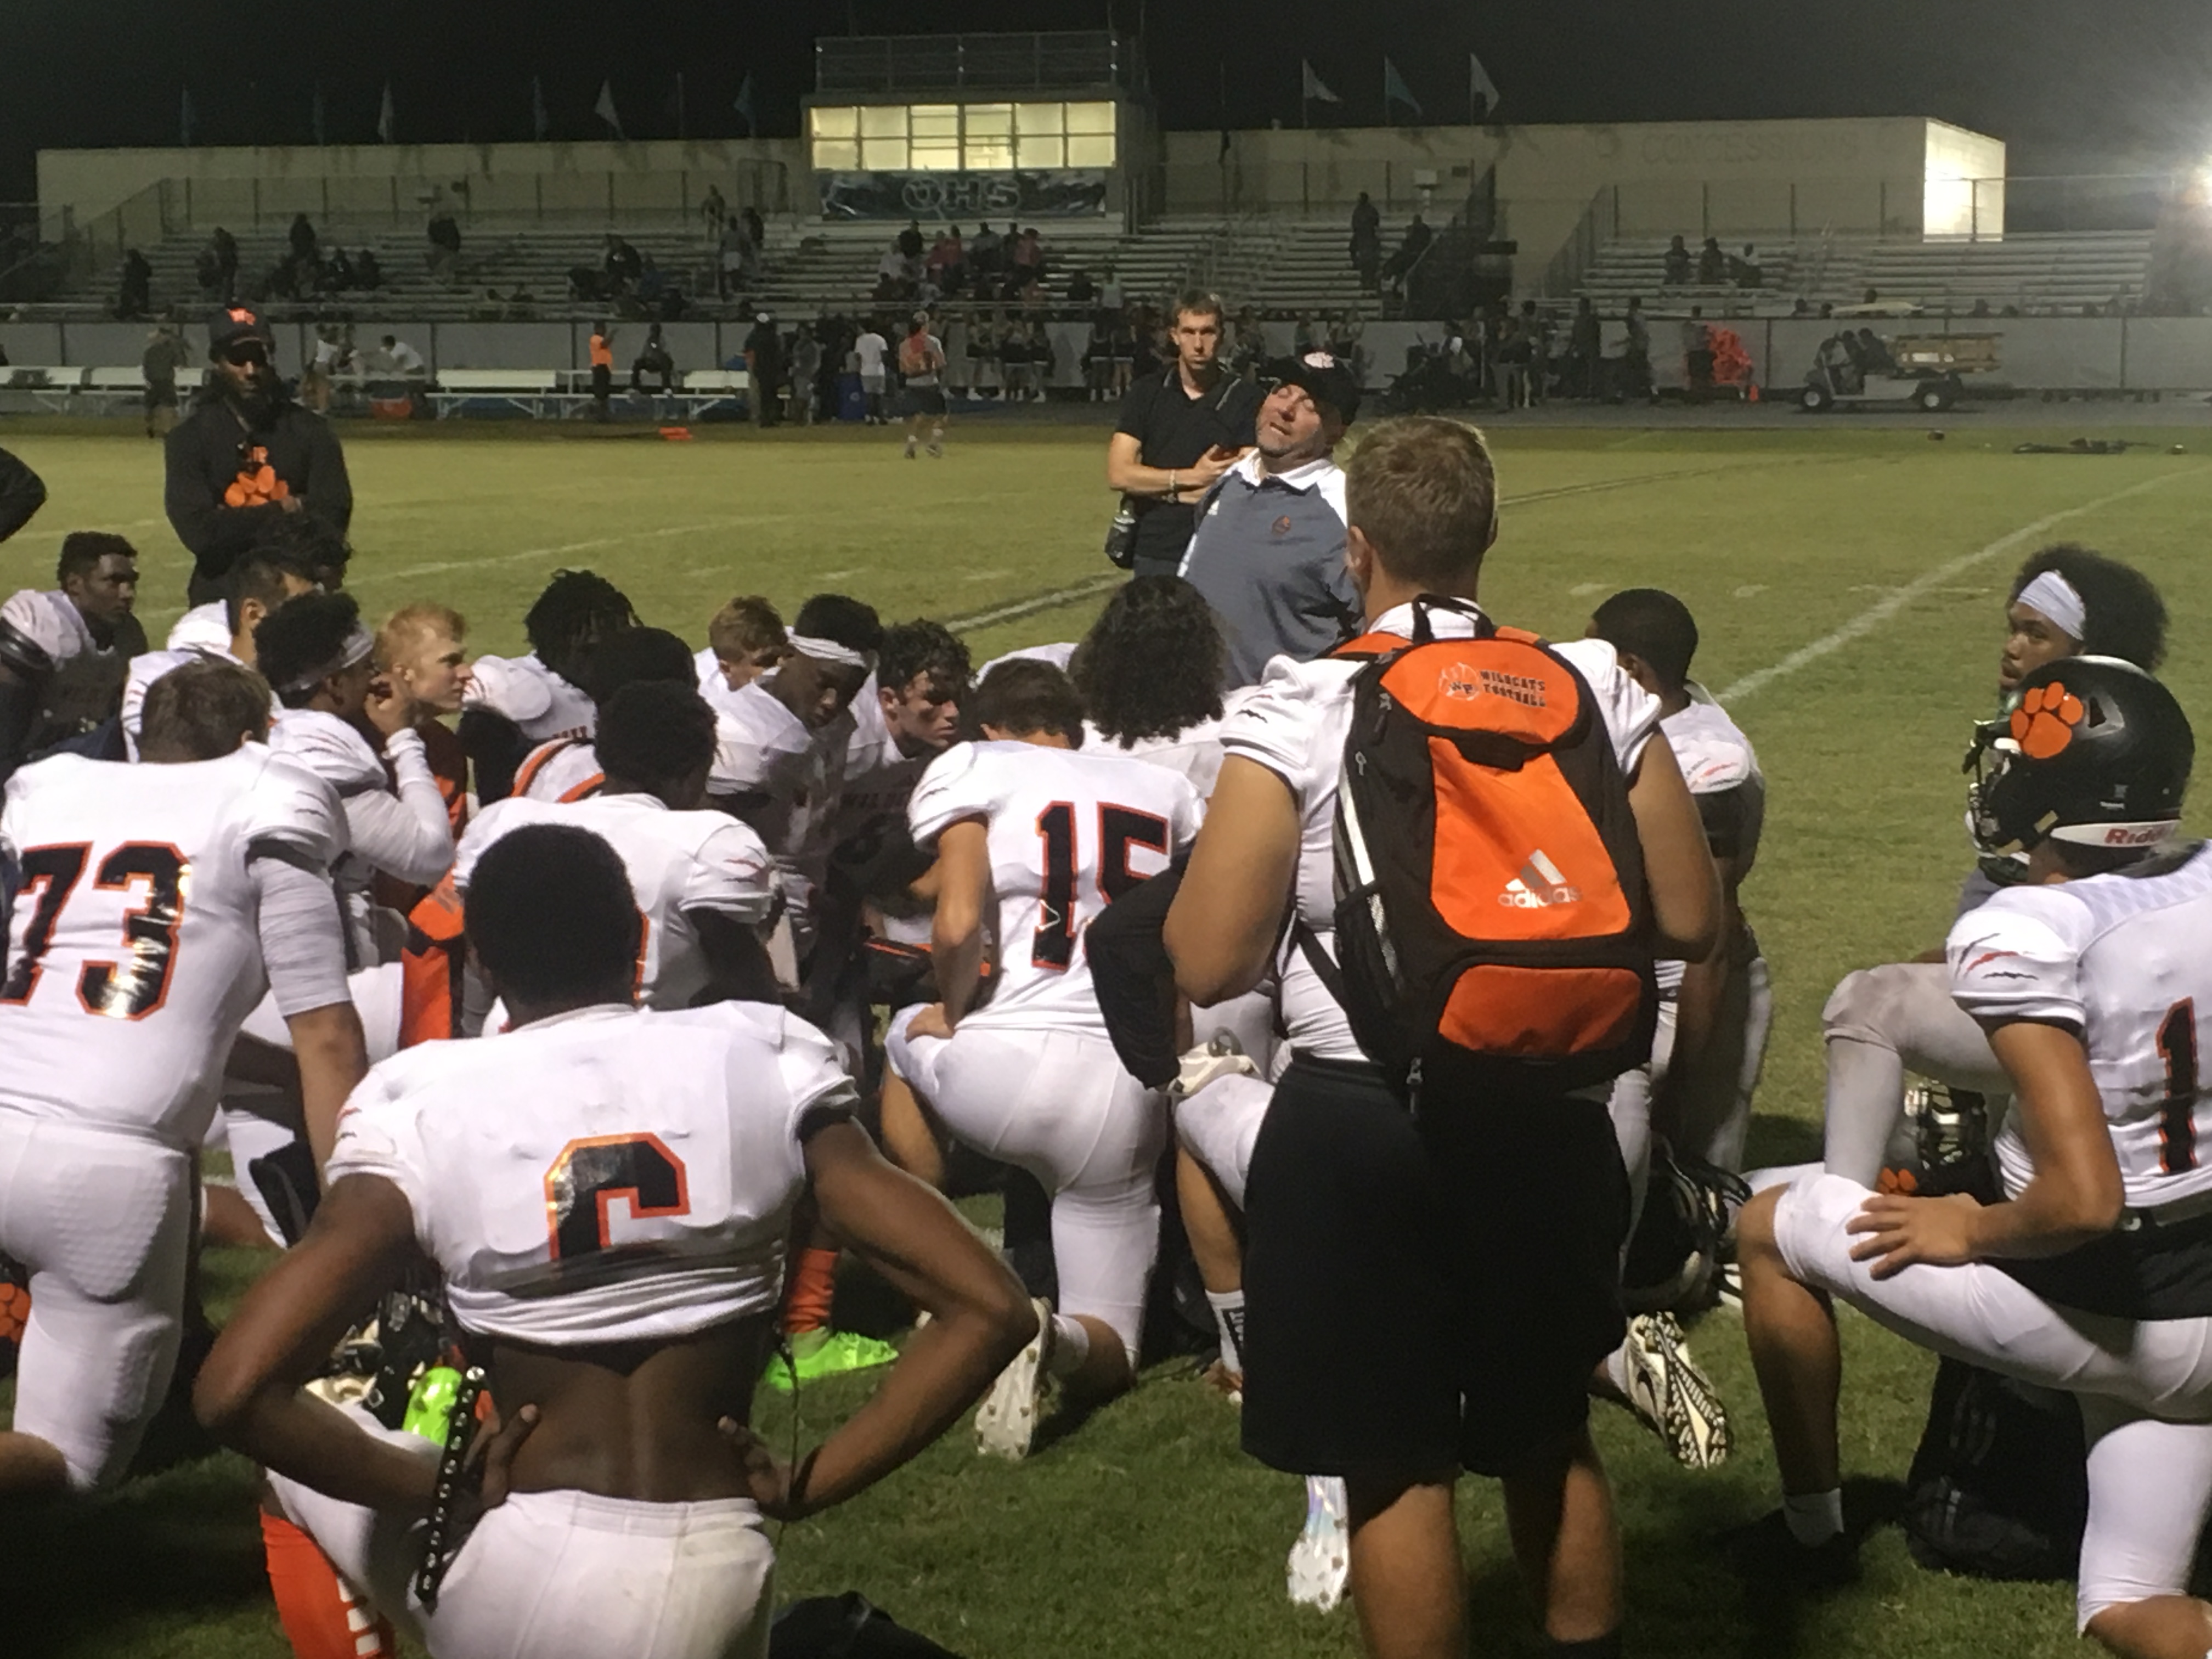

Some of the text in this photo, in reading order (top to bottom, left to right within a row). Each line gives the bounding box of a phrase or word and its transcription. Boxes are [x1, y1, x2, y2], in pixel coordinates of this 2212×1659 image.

[1480, 669, 1545, 691] WILDCATS
[0, 840, 192, 1022] 73
[1032, 800, 1170, 972] 15
[1497, 885, 1583, 909] adidas
[2156, 996, 2199, 1173] 1
